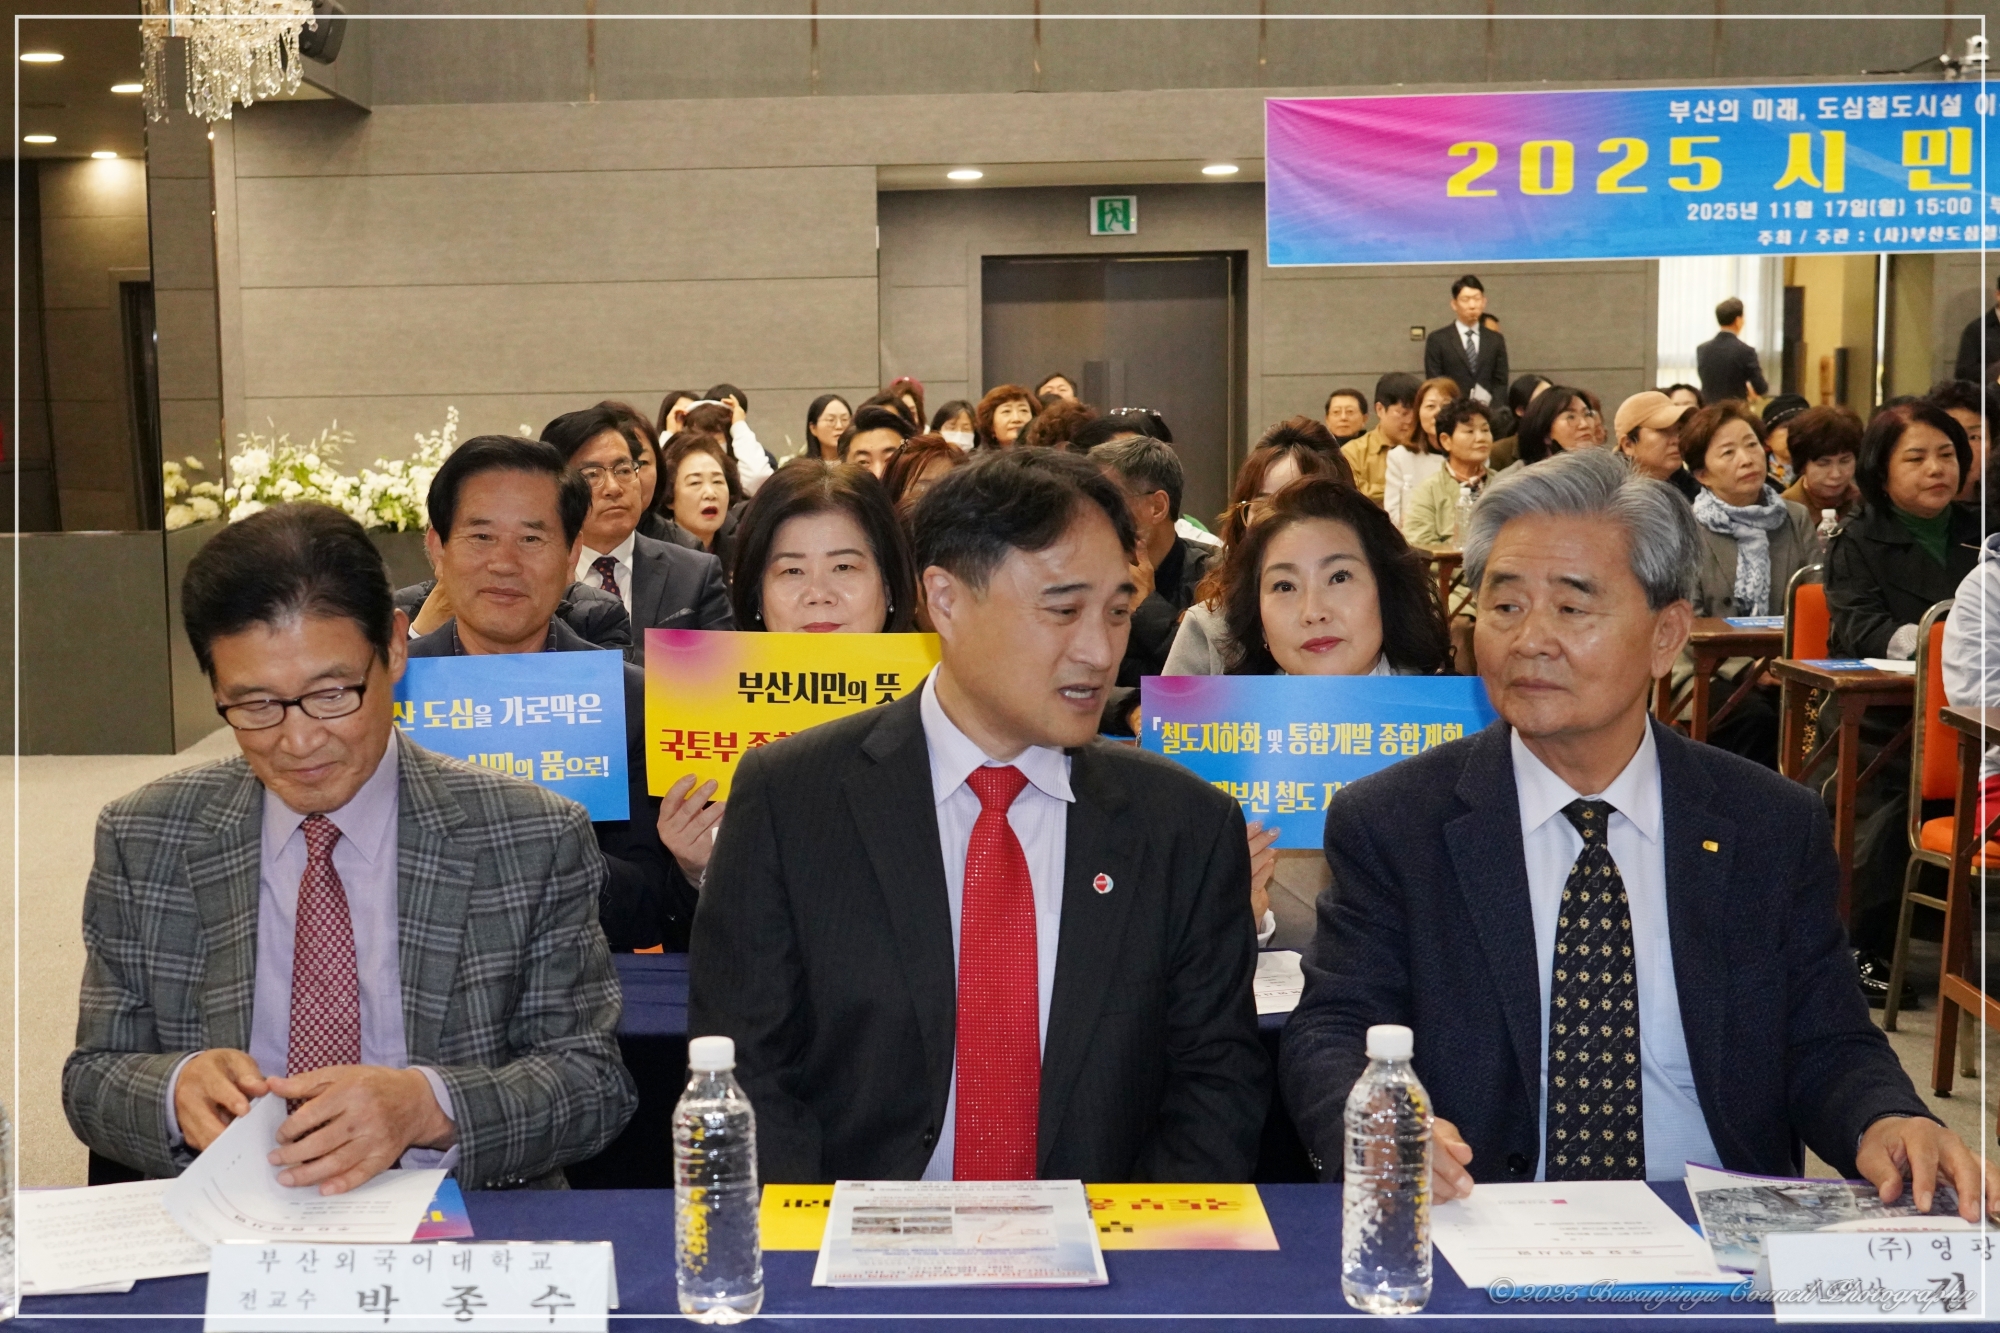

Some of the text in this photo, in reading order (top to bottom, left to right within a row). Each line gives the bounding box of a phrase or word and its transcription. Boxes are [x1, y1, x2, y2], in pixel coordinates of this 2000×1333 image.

[1668, 99, 1740, 124] 부산의
[1752, 98, 1806, 122] 미래,
[1817, 94, 1962, 119] 도심철도시설
[1446, 136, 1723, 197] 2025
[1687, 201, 1758, 221] 2025년
[1769, 200, 1813, 219] 11월
[1824, 197, 1906, 218] 17일(월)
[1915, 197, 1972, 216] 15:00
[1874, 224, 2000, 244] (사)부산도심철
[738, 671, 902, 705] 부산시민의 뜻
[423, 698, 493, 730] 도심을
[499, 693, 603, 727] 가로막은
[659, 728, 739, 762] 국토부
[1267, 728, 1283, 754] 및
[1287, 722, 1374, 756] 통합개발
[540, 750, 610, 782] 품으로!
[1275, 780, 1317, 814] 철도
